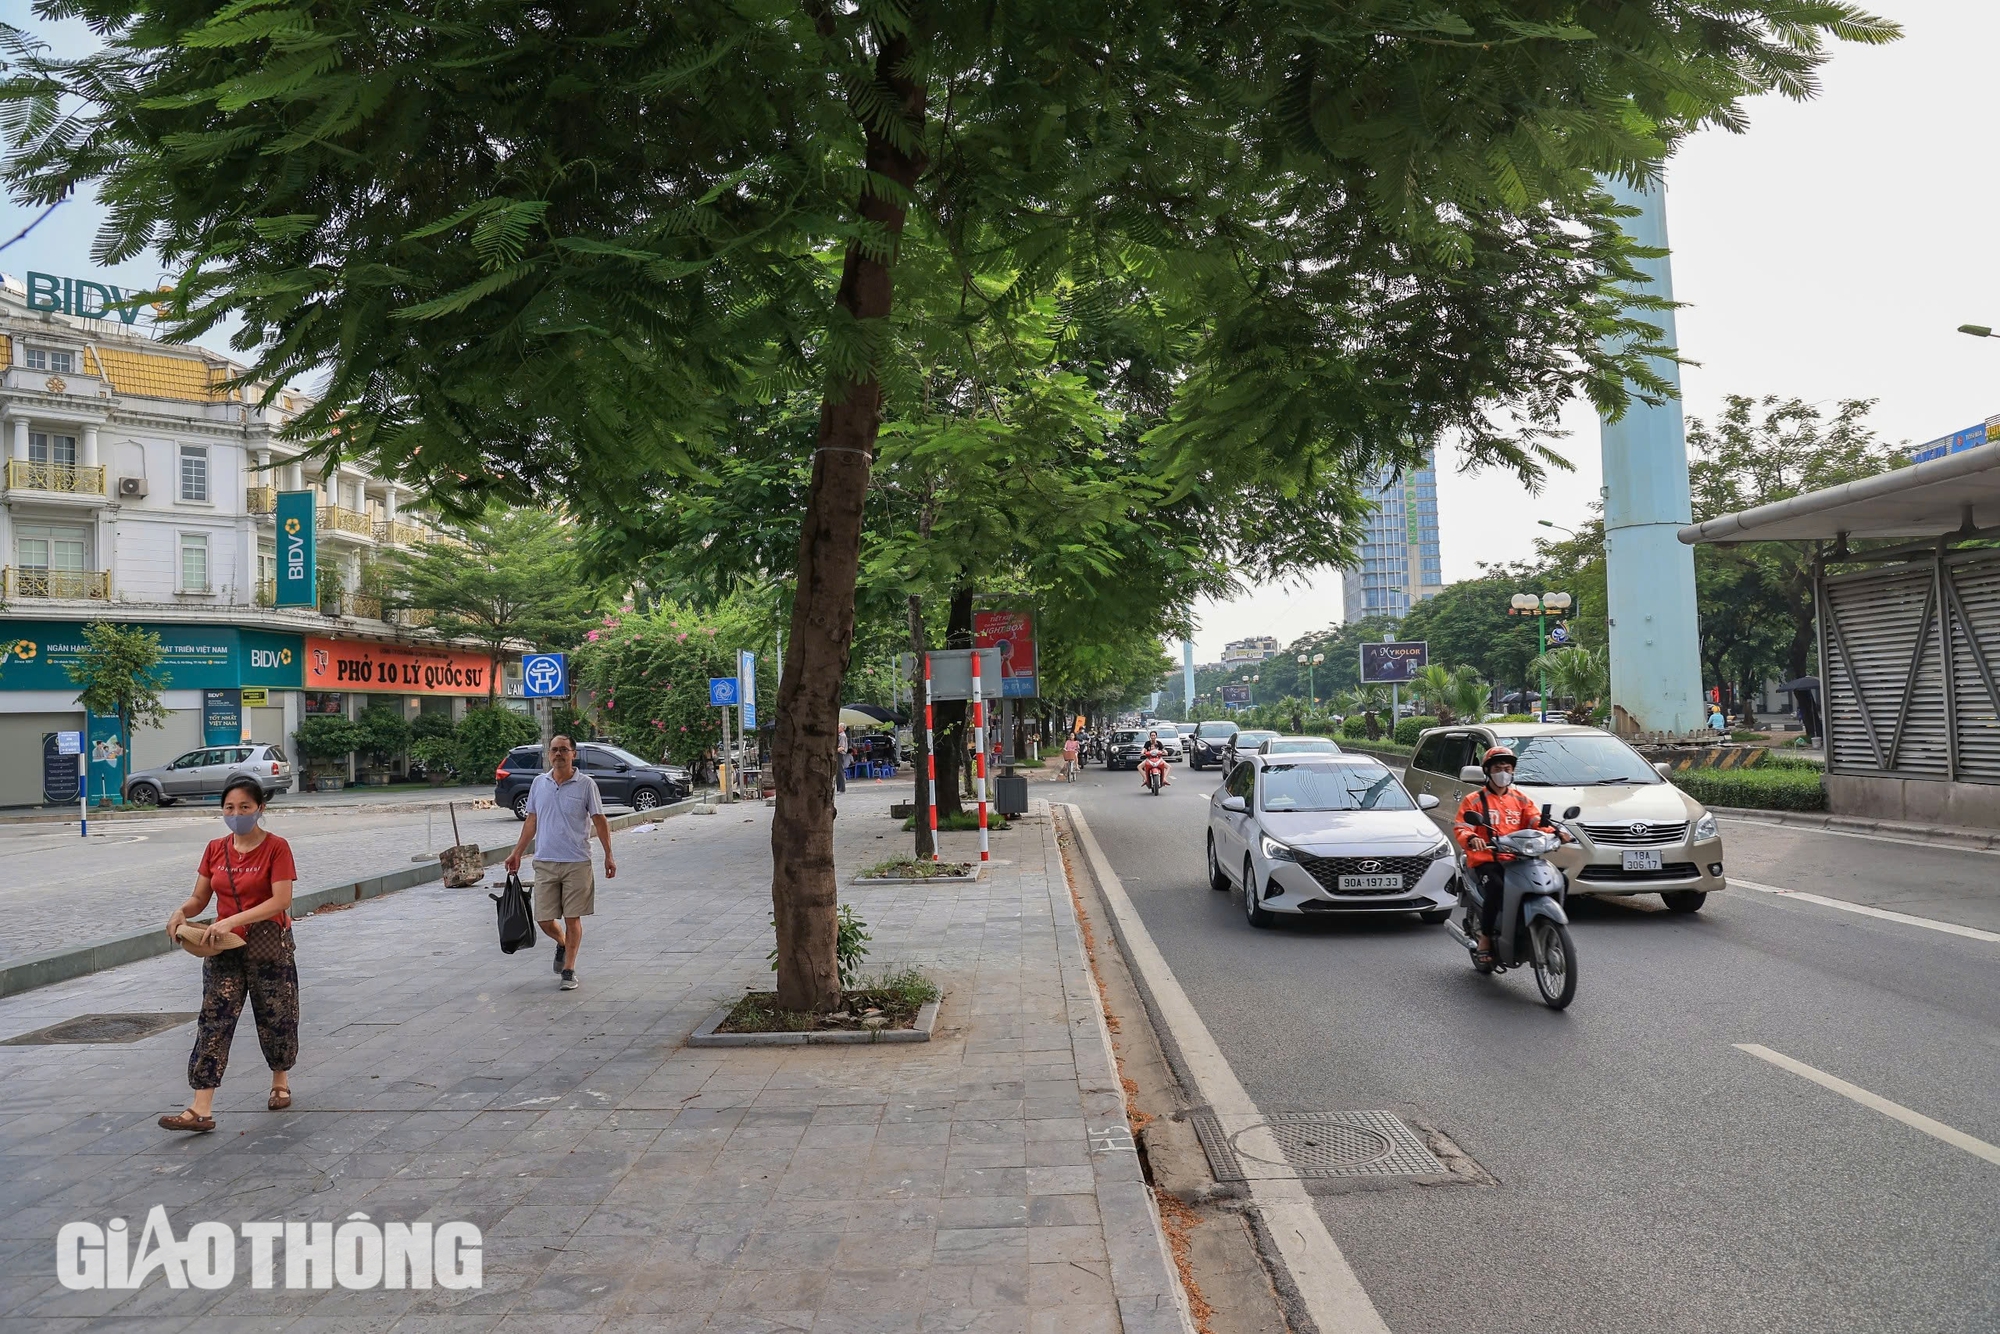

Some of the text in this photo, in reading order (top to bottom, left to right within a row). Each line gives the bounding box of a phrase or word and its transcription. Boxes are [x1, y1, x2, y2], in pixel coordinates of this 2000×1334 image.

[27, 271, 143, 325] BIDV
[1405, 490, 1418, 545] GARDEN
[288, 534, 304, 580] BIDV
[47, 644, 69, 652] NGÂN
[174, 645, 195, 653] TRIỂN
[196, 645, 211, 654] VIỆT
[212, 646, 228, 654] NAM
[251, 649, 281, 668] BIDV
[337, 653, 483, 690] PHỞ 10 LÝ QUỐC SƯ
[1634, 851, 1651, 860] 18A
[1627, 860, 1658, 870] 306.17
[1344, 877, 1398, 888] 90A-197.33
